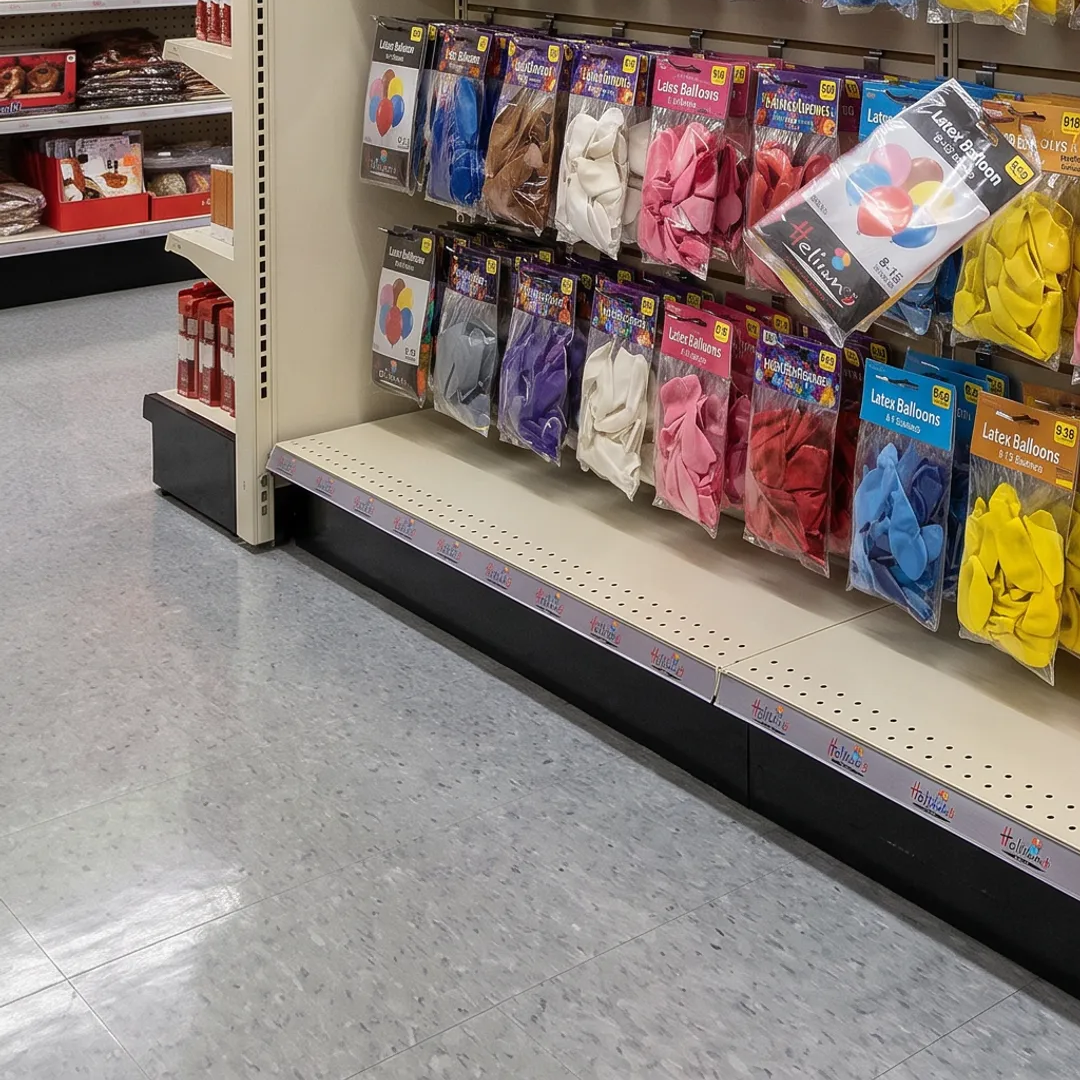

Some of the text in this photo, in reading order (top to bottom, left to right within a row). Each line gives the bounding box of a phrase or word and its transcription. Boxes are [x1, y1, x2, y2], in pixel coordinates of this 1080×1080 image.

[870, 388, 896, 412] Latex
[896, 398, 941, 429] Balloons
[982, 422, 1061, 466] Latex Balloons
